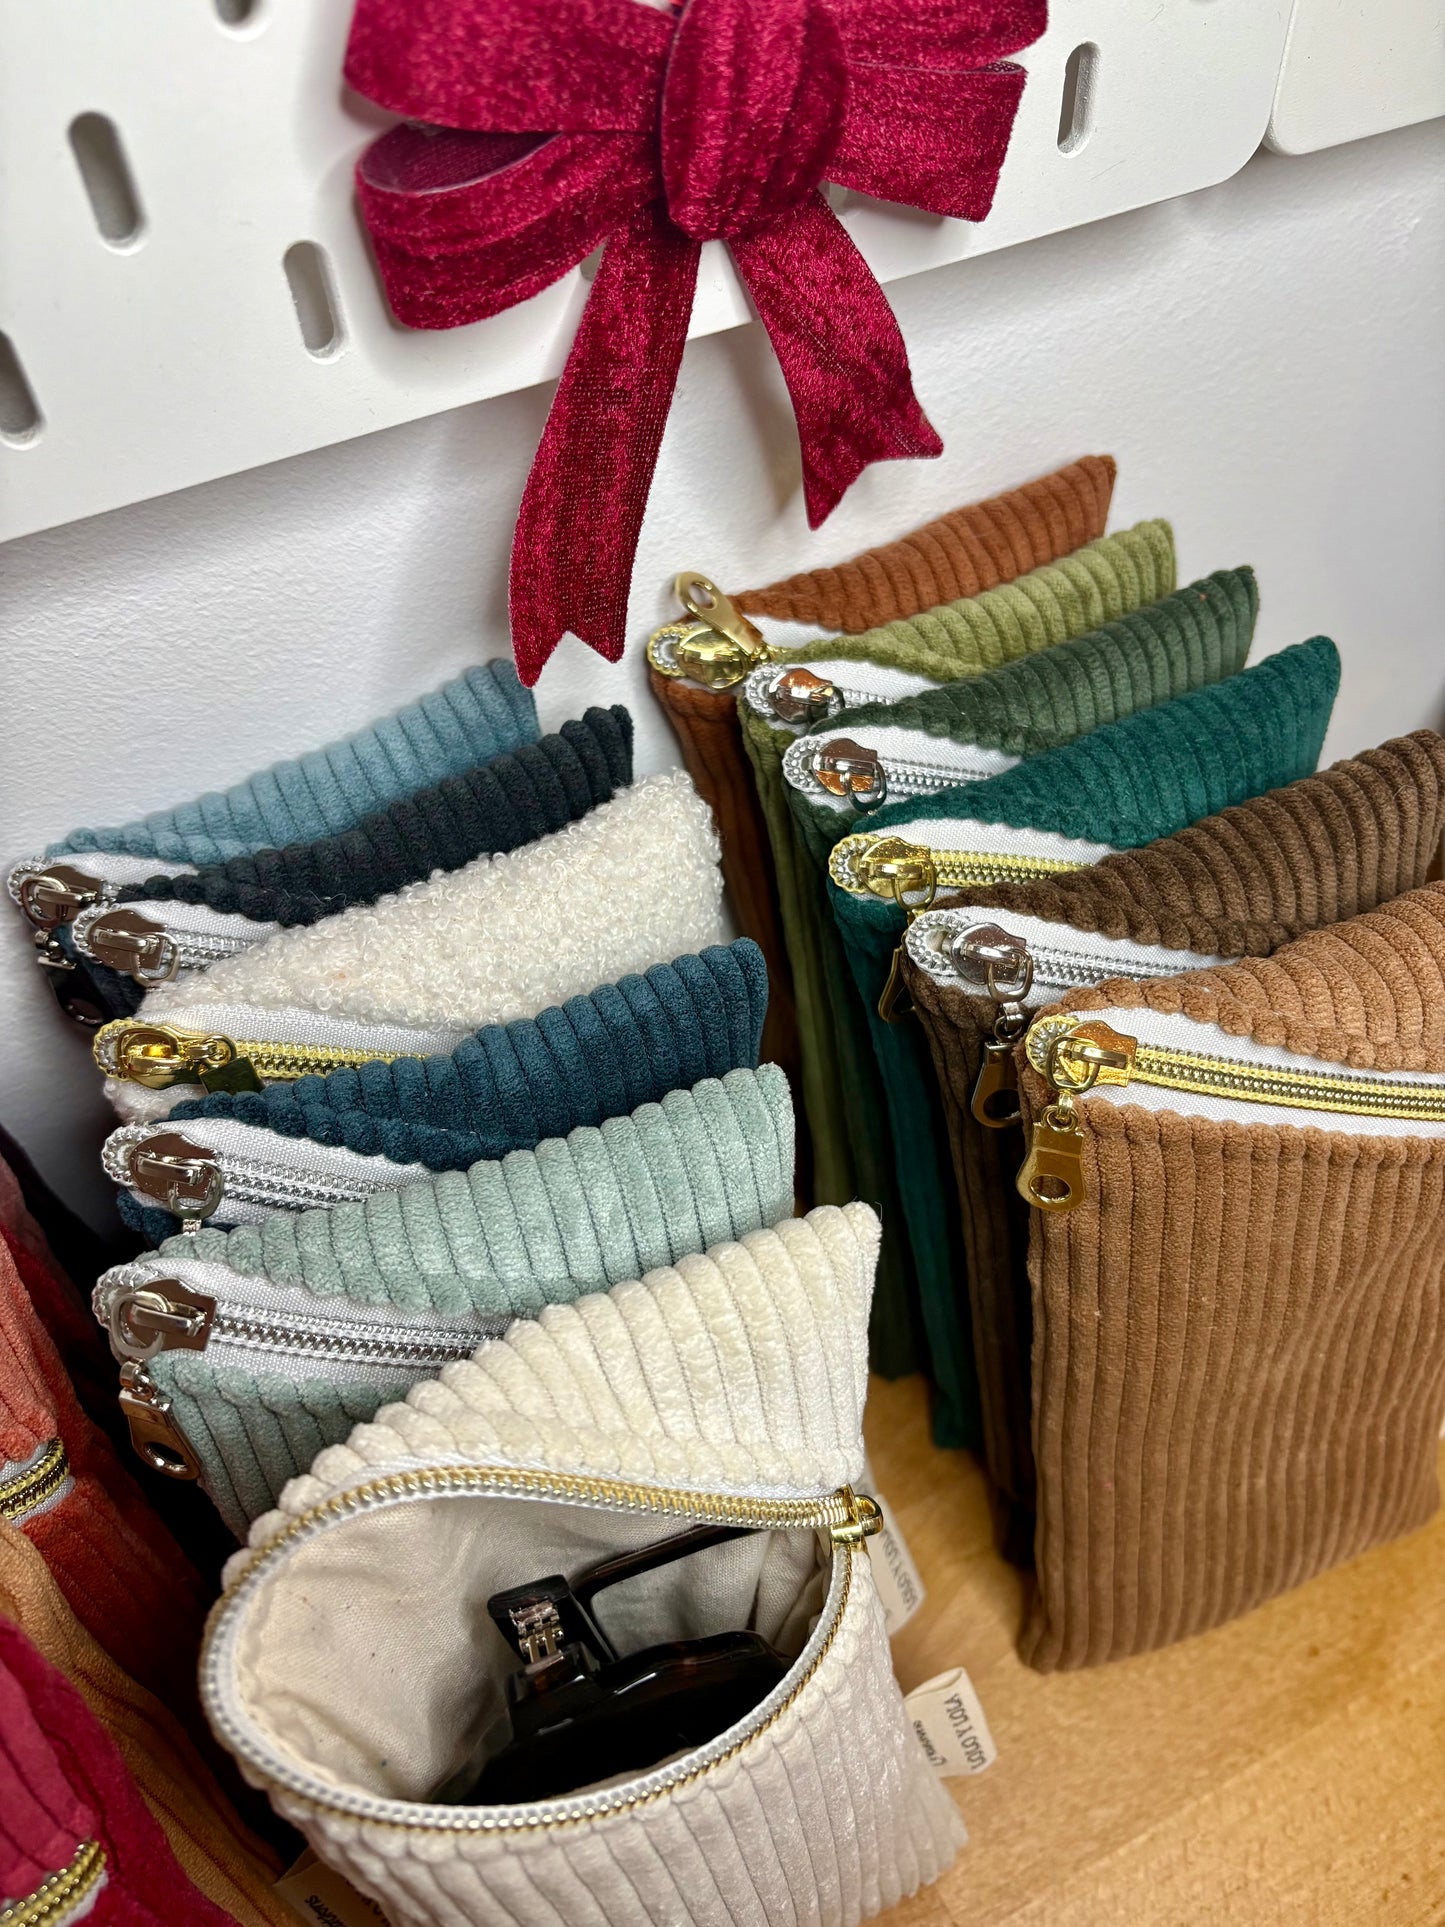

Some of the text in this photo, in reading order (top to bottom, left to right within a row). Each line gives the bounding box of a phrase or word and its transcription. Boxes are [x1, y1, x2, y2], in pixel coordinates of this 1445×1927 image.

[944, 1692, 987, 1770] LOLO Y LOLA
